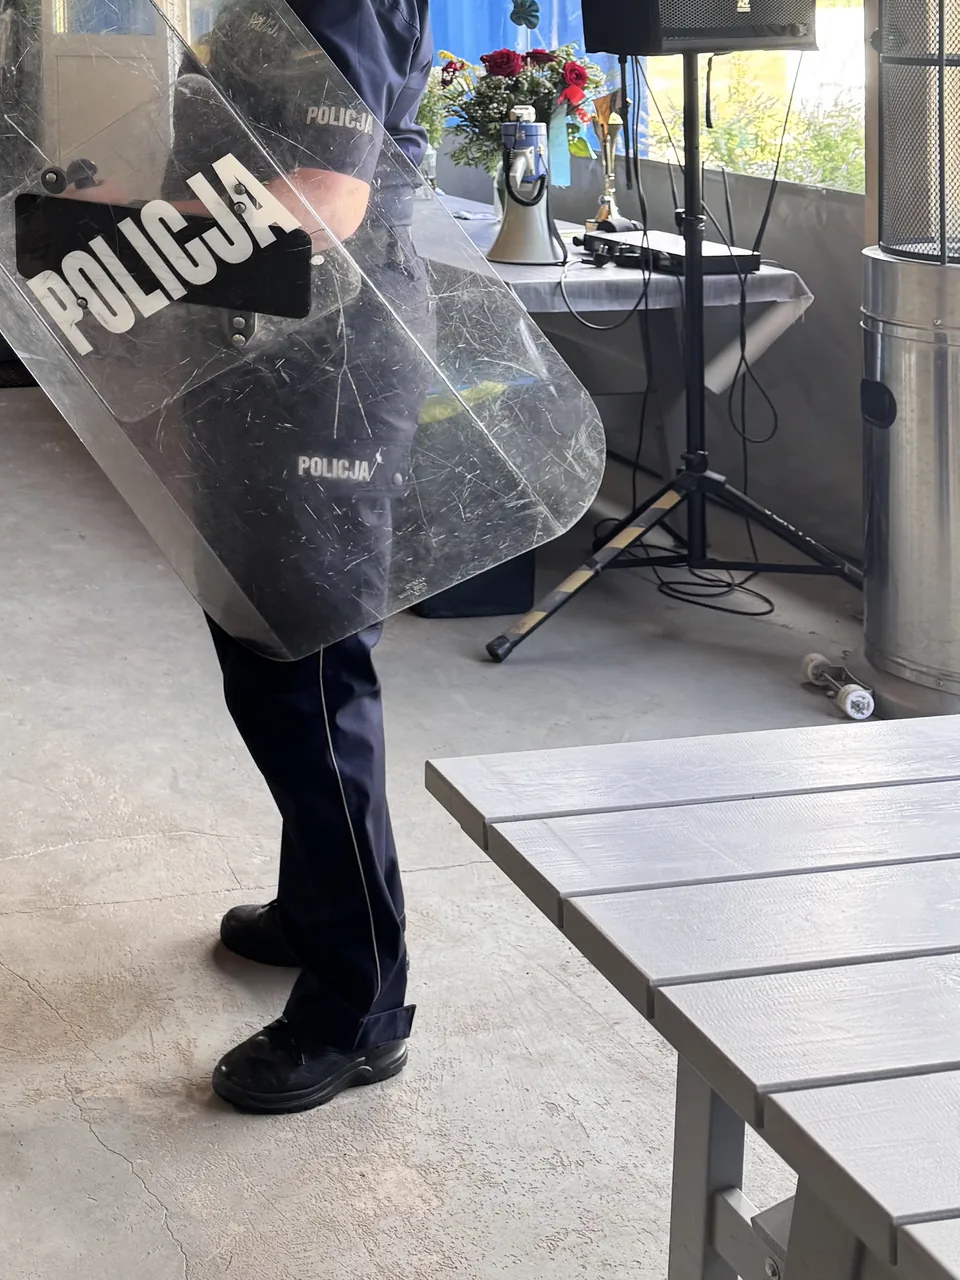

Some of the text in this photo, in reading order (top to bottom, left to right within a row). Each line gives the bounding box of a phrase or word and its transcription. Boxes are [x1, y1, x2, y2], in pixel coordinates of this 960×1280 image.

[306, 106, 374, 135] POLICJA
[25, 152, 302, 356] POLICJA
[298, 455, 370, 480] POLICJA
